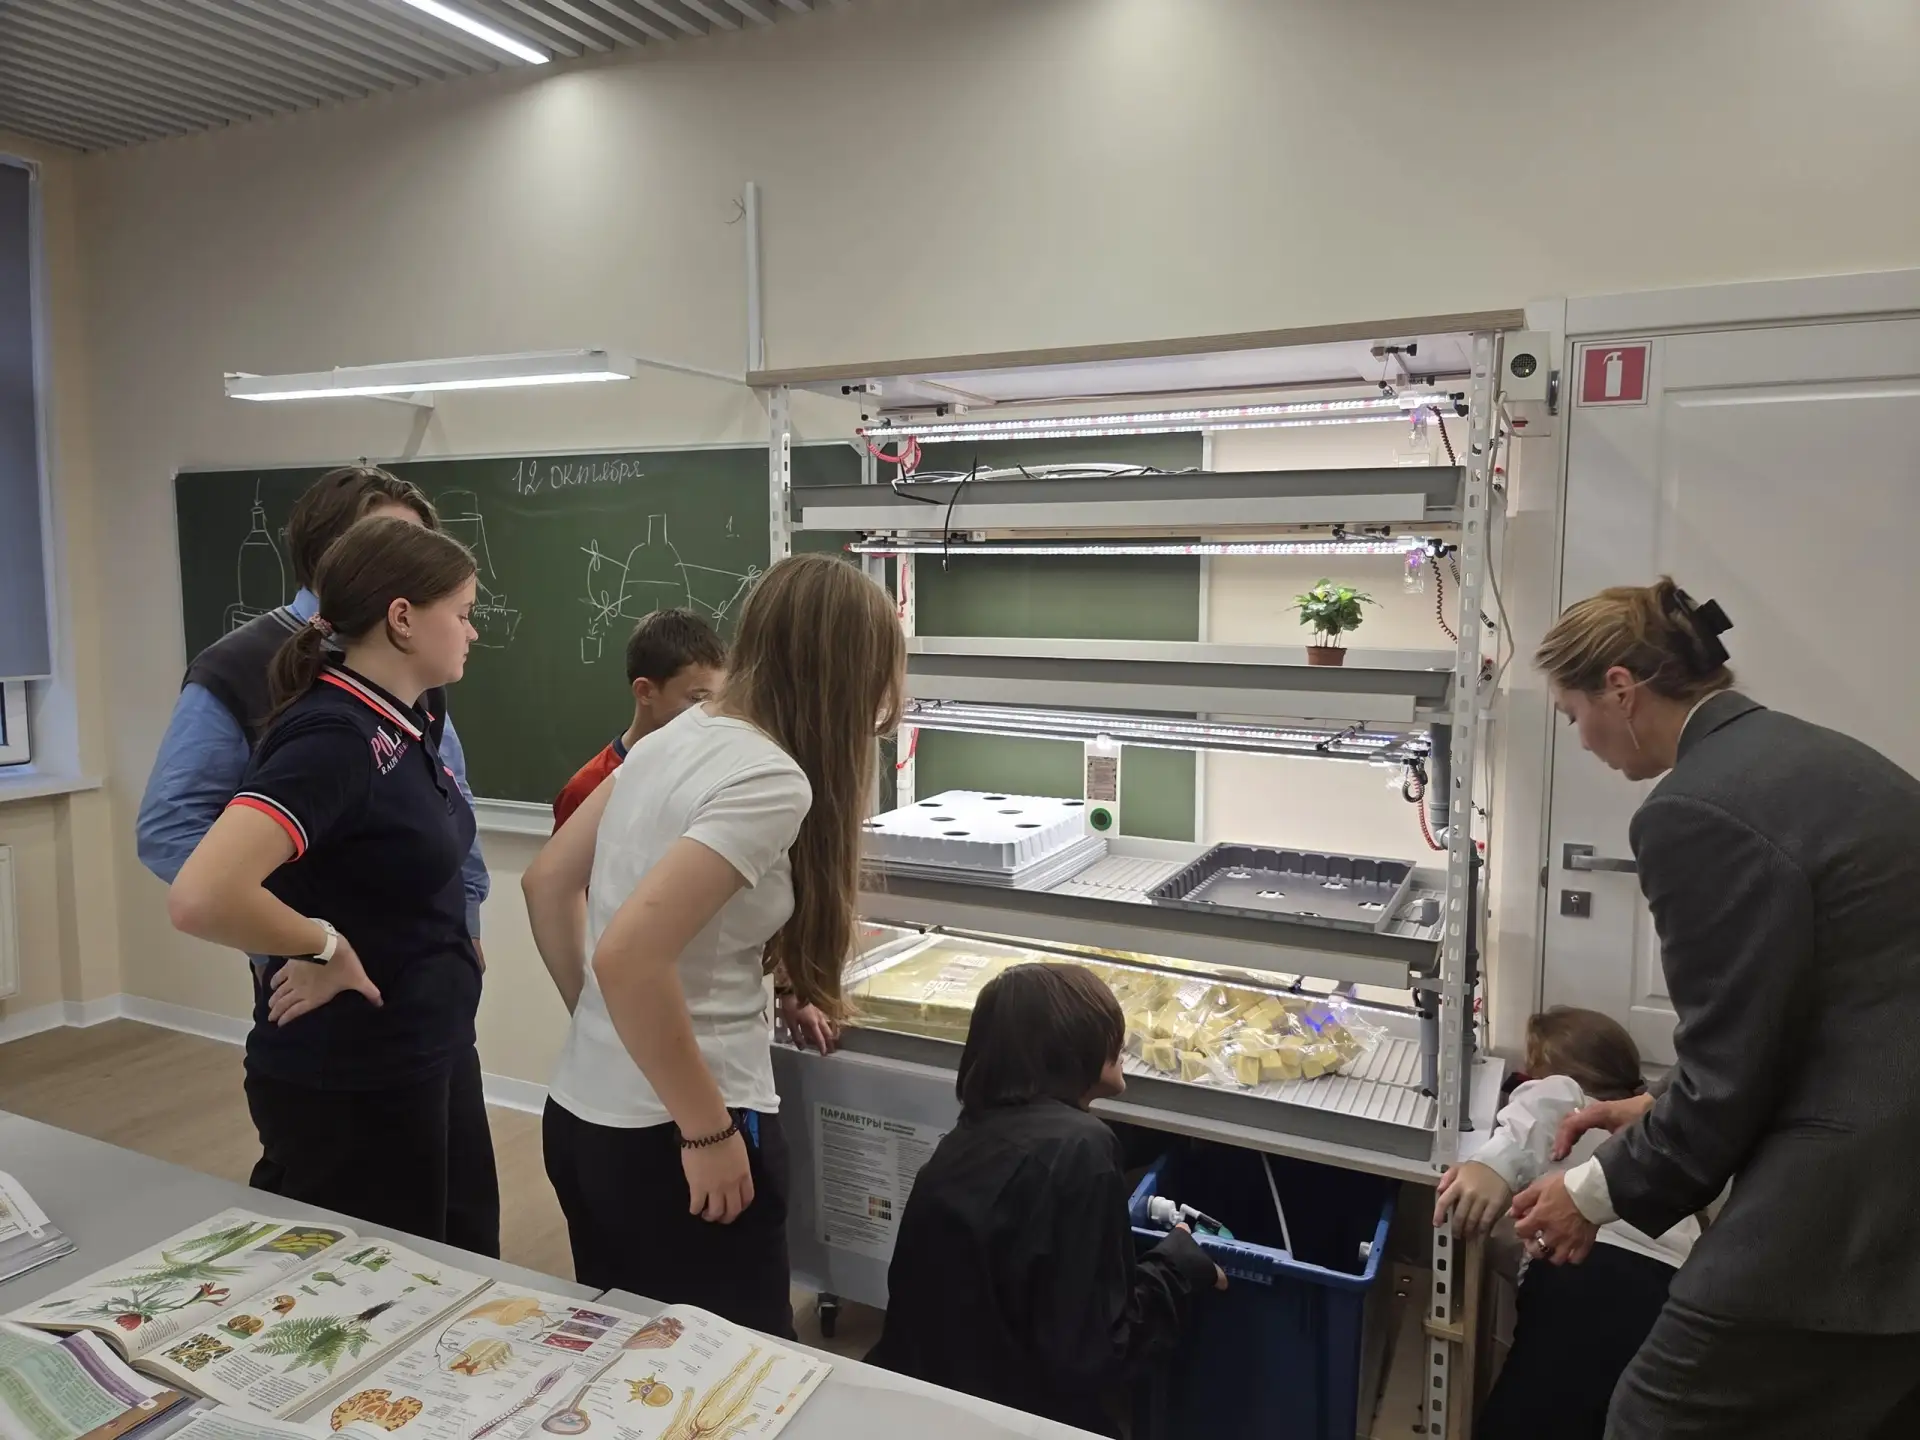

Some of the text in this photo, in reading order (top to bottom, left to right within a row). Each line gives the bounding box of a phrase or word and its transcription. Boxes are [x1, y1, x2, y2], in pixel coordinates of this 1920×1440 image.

[512, 460, 544, 496] 12
[370, 725, 402, 769] POL
[820, 1106, 882, 1129] ПАРАМЕТРЫ
